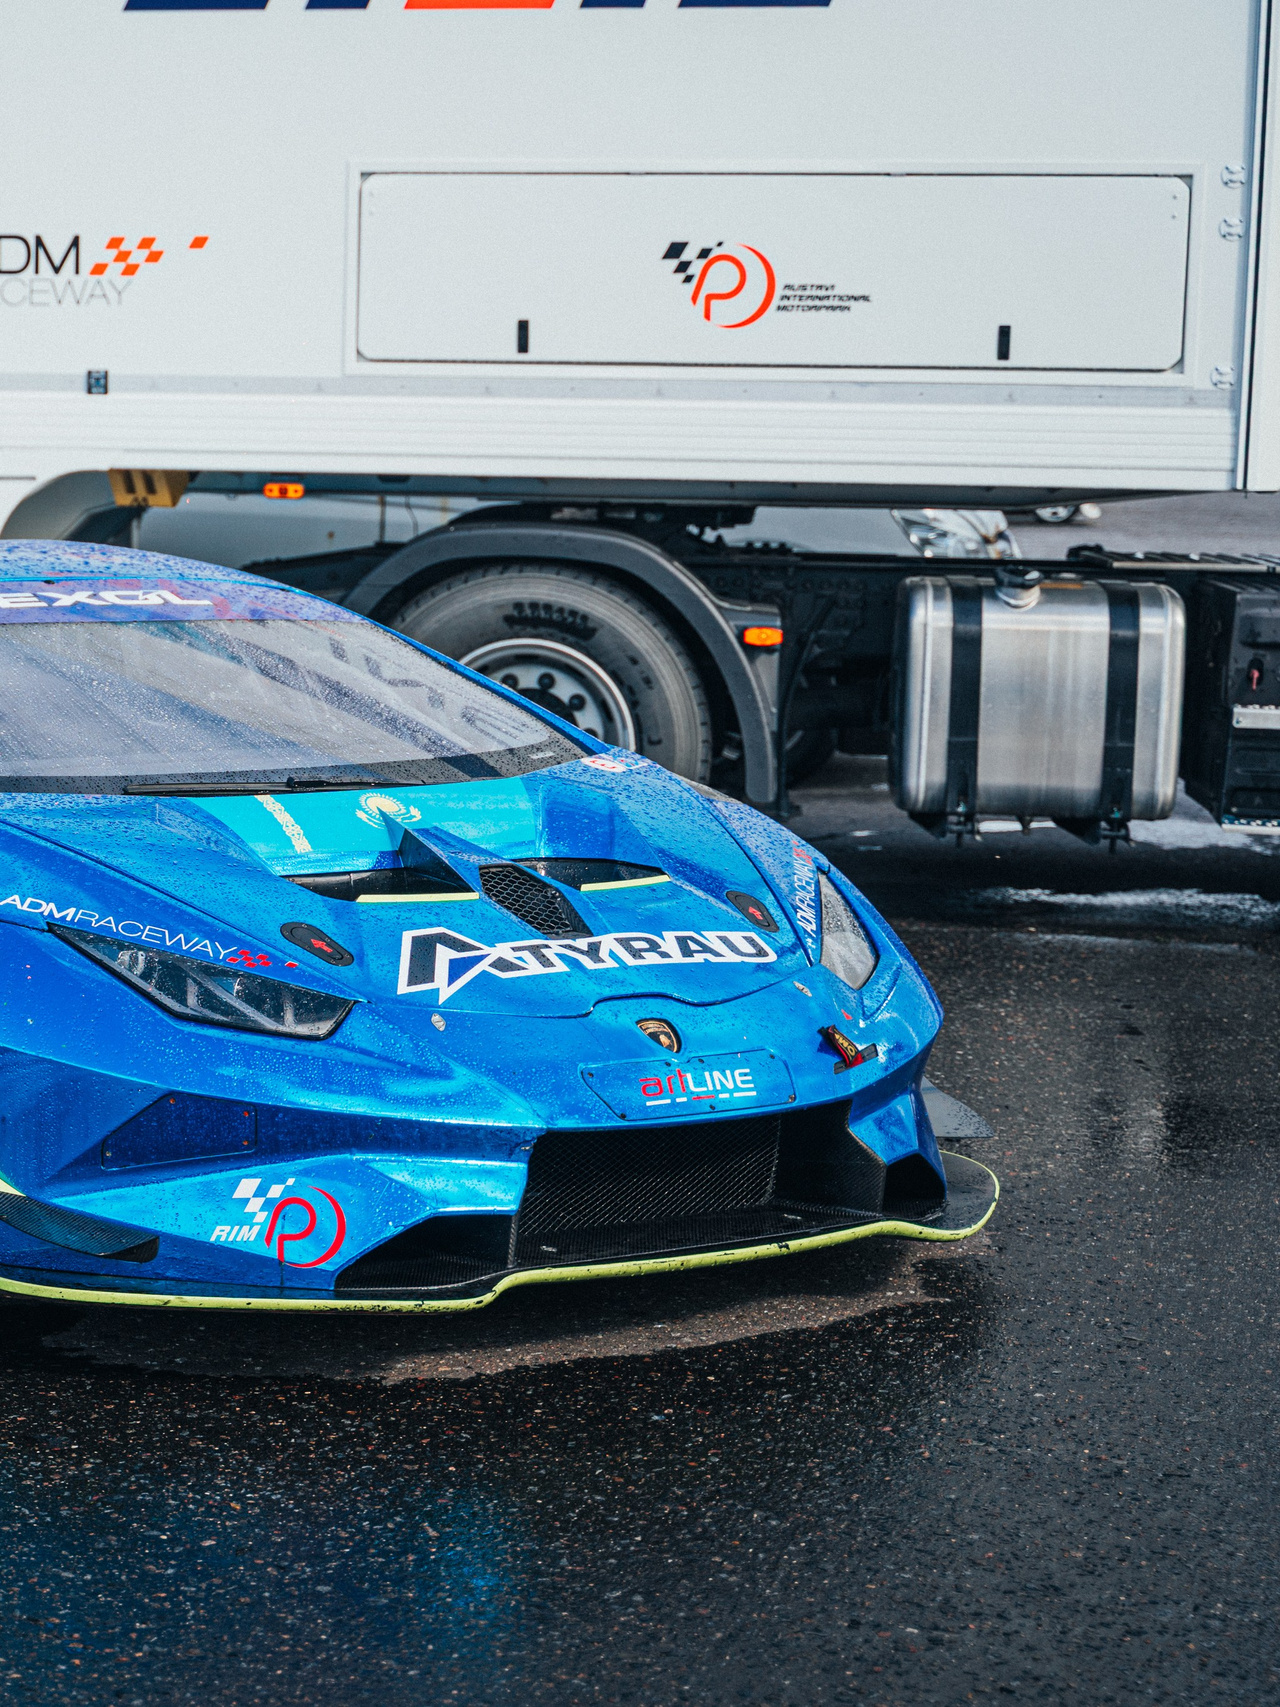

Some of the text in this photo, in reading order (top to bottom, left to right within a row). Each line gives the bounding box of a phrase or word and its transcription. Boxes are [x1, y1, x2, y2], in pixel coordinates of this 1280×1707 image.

[397, 926, 778, 1005] ATYRAU
[638, 1068, 755, 1098] artLINE
[209, 1225, 262, 1242] RIM
